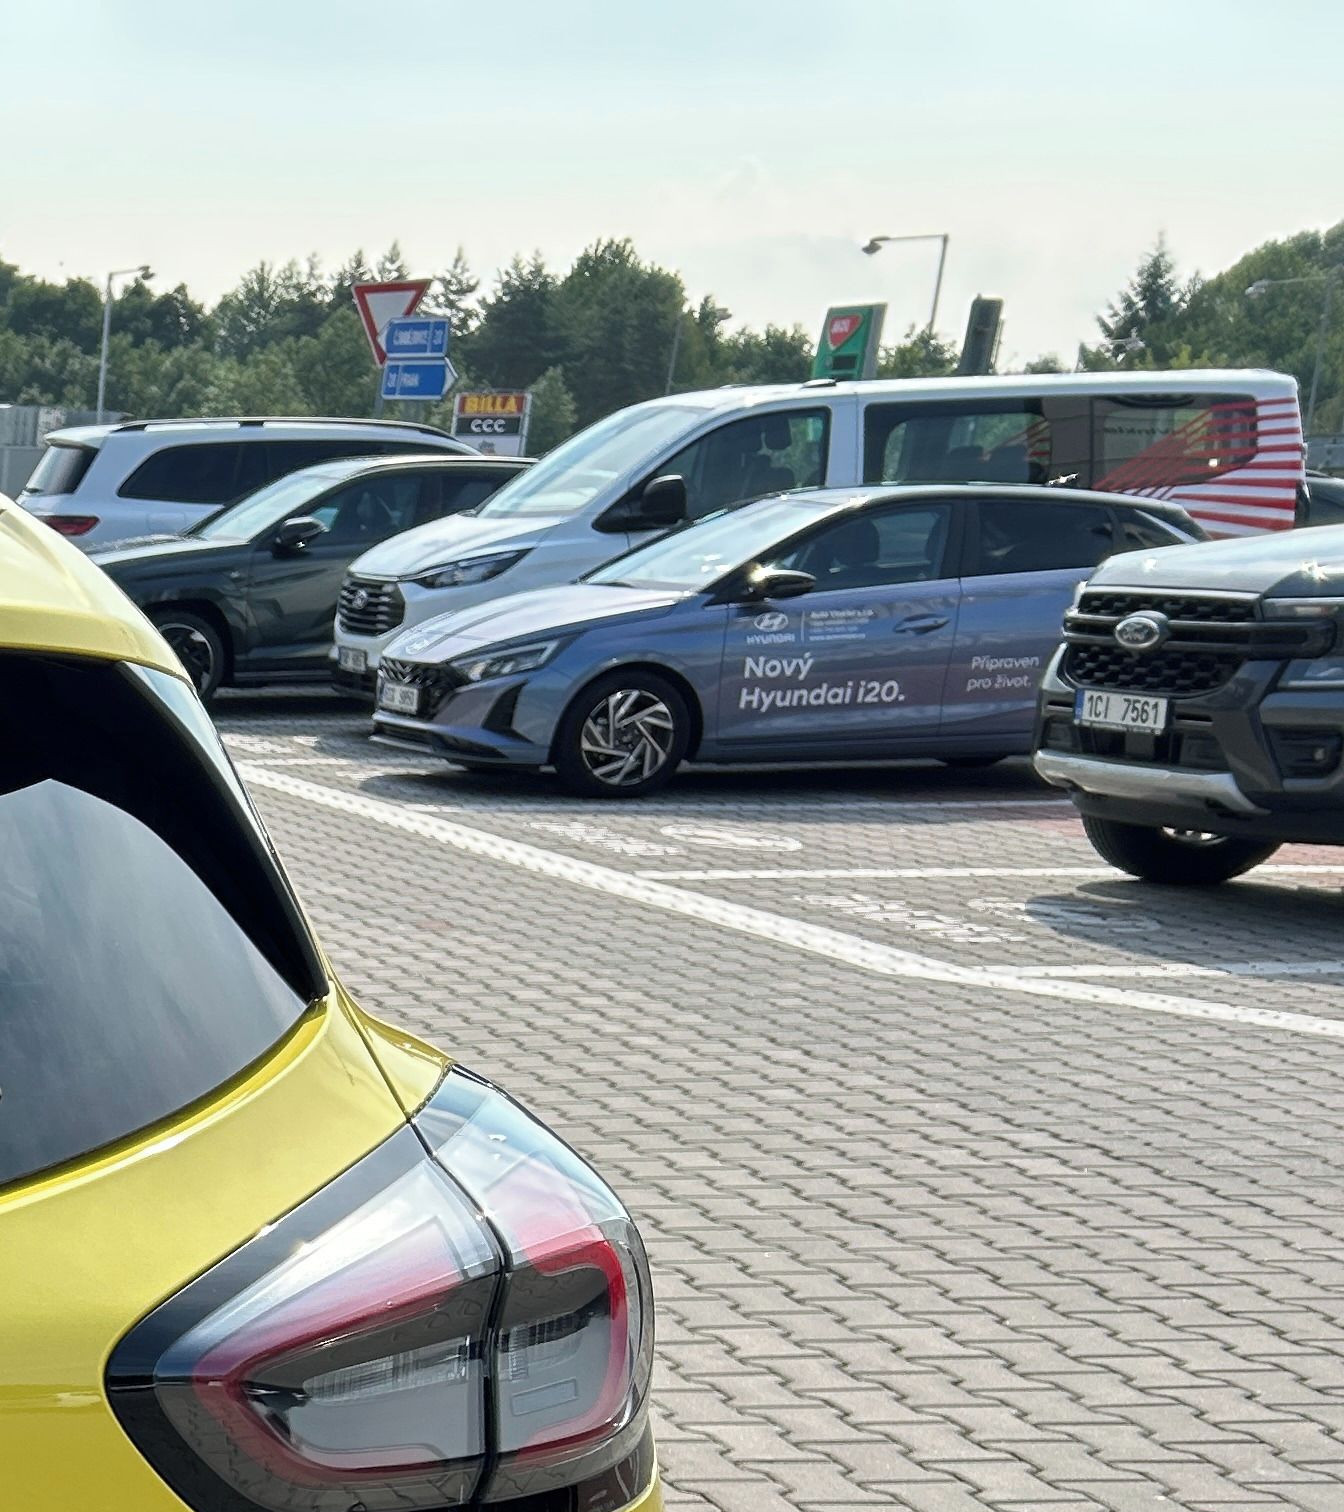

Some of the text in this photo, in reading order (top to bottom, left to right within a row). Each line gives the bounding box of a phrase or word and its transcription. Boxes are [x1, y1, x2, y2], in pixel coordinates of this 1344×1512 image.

[464, 395, 518, 413] BILLA
[746, 632, 796, 645] HYUNDAI
[744, 652, 814, 681] Nový
[739, 680, 906, 713] Hyundai i20.
[966, 678, 992, 692] pro
[1122, 697, 1160, 725] 7561
